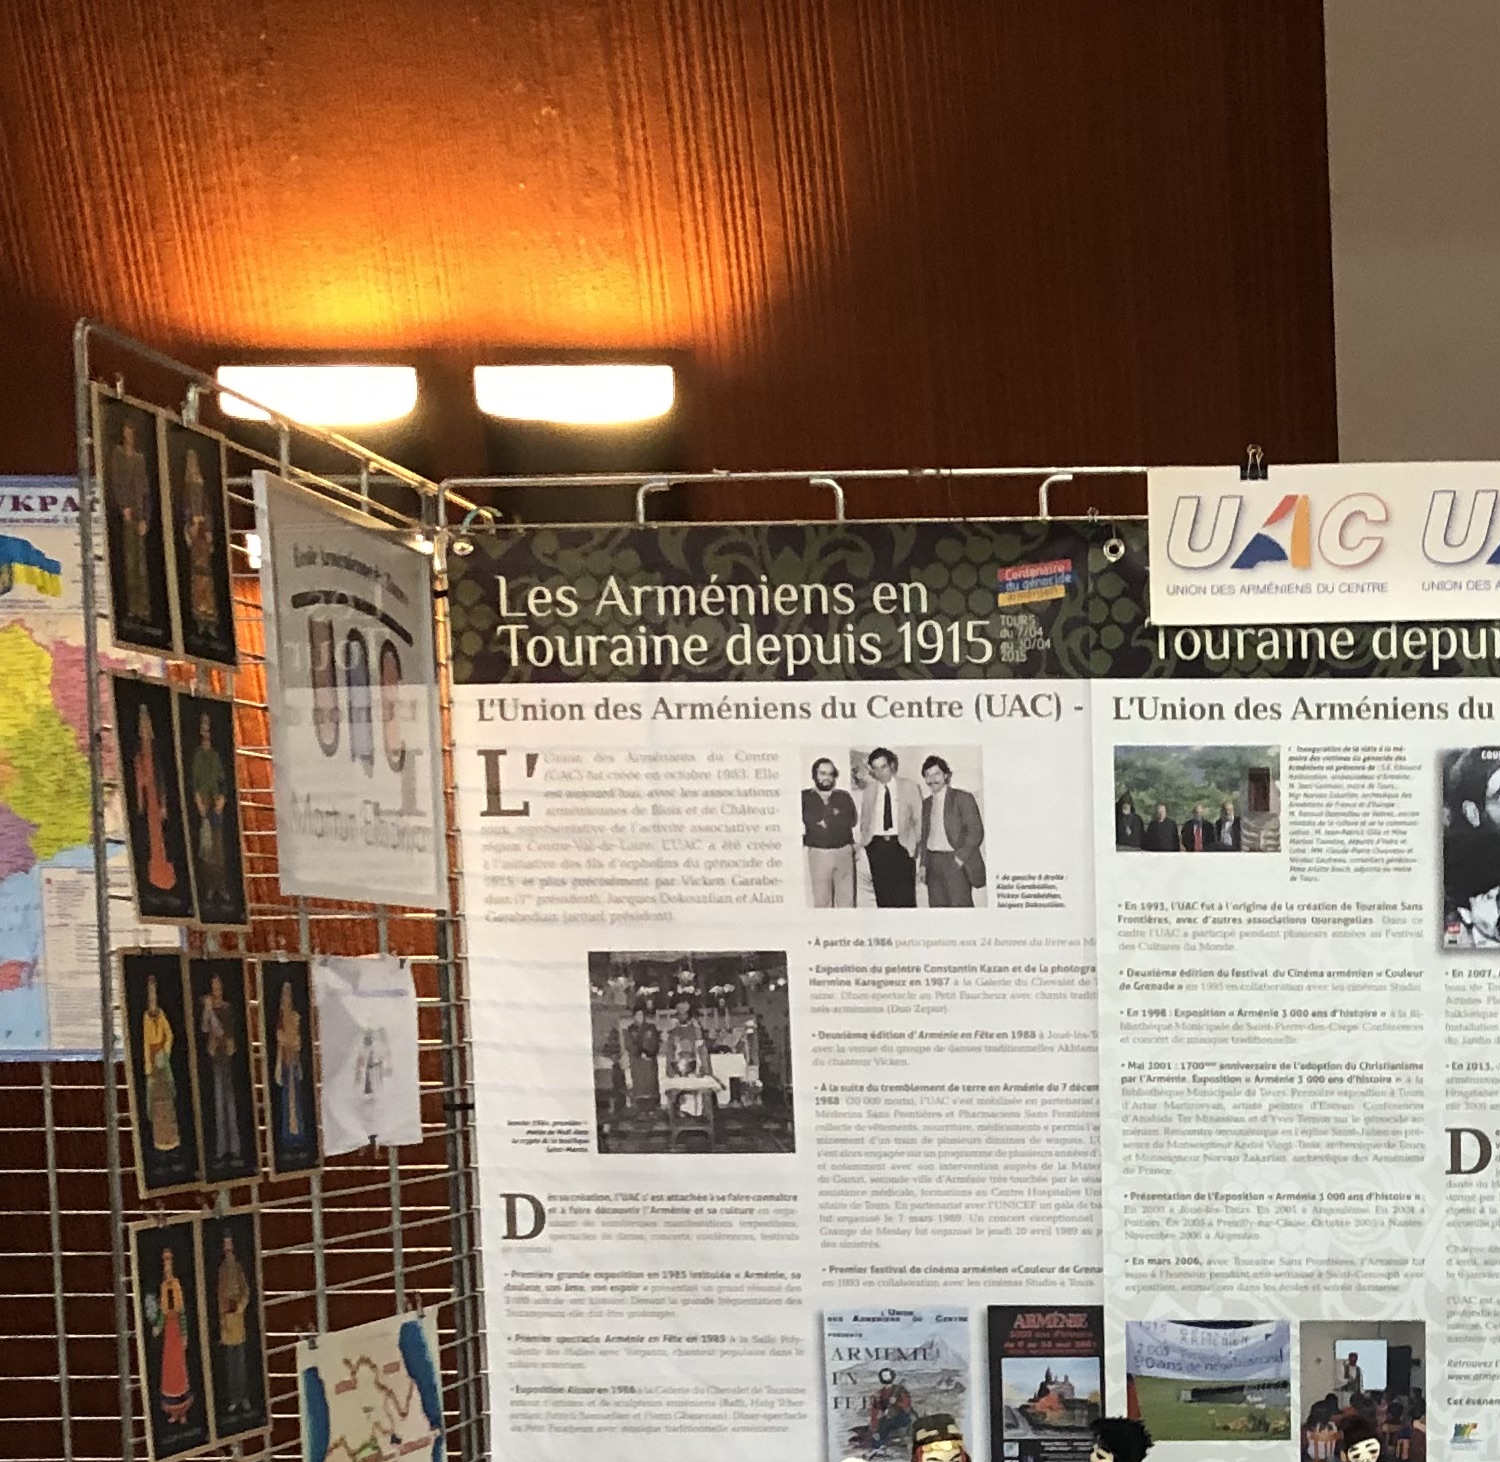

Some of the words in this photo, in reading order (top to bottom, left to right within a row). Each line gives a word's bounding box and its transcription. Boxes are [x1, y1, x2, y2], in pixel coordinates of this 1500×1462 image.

[1167, 492, 1389, 570] UAC
[1004, 563, 1066, 579] Centenaire
[1421, 579, 1463, 591] UNION
[1465, 578, 1491, 591] DES
[498, 574, 578, 618] Les
[595, 573, 855, 617] Arméniens
[872, 581, 928, 614] en
[1165, 583, 1207, 596] UNION
[1209, 583, 1236, 596] DES
[1239, 581, 1312, 595] ARMÉNIENS
[1315, 581, 1335, 595] DU
[1337, 581, 1388, 594] CENTRE
[999, 614, 1036, 627] TOURS
[496, 622, 708, 667] Touraine
[725, 621, 882, 673] depuis
[899, 618, 993, 664] 1915
[1153, 622, 1356, 661] Touraine
[477, 696, 584, 722] L'Union
[593, 696, 642, 721] des
[652, 694, 811, 721] Arméniens
[820, 694, 856, 719] du
[865, 693, 963, 719] Centre
[974, 692, 1061, 722] (UAC)
[1113, 695, 1224, 721] L'Union
[1233, 695, 1282, 721] des
[1291, 695, 1449, 721] Arméniens
[1457, 695, 1493, 720] du
